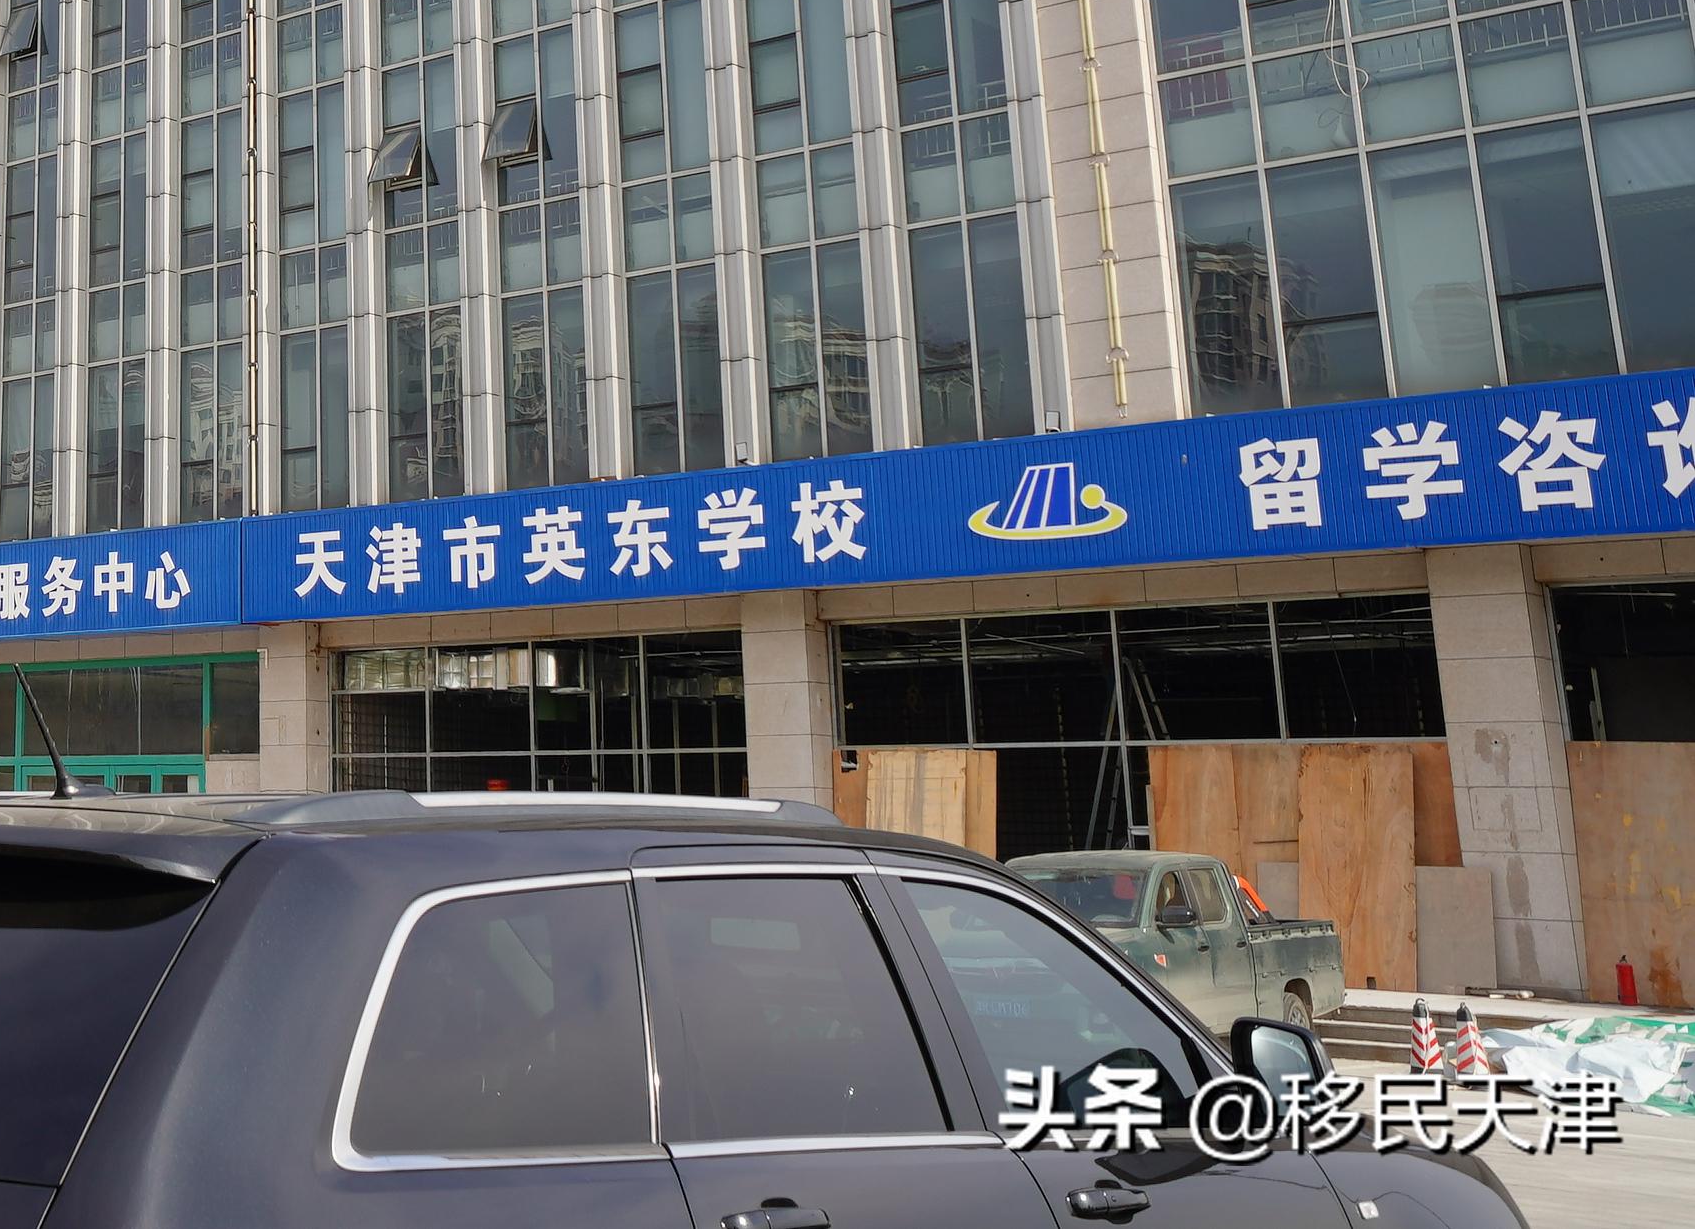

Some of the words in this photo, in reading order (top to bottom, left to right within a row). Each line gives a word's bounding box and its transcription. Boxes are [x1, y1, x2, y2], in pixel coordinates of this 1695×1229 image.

[295, 480, 867, 597] 天津市英东学校
